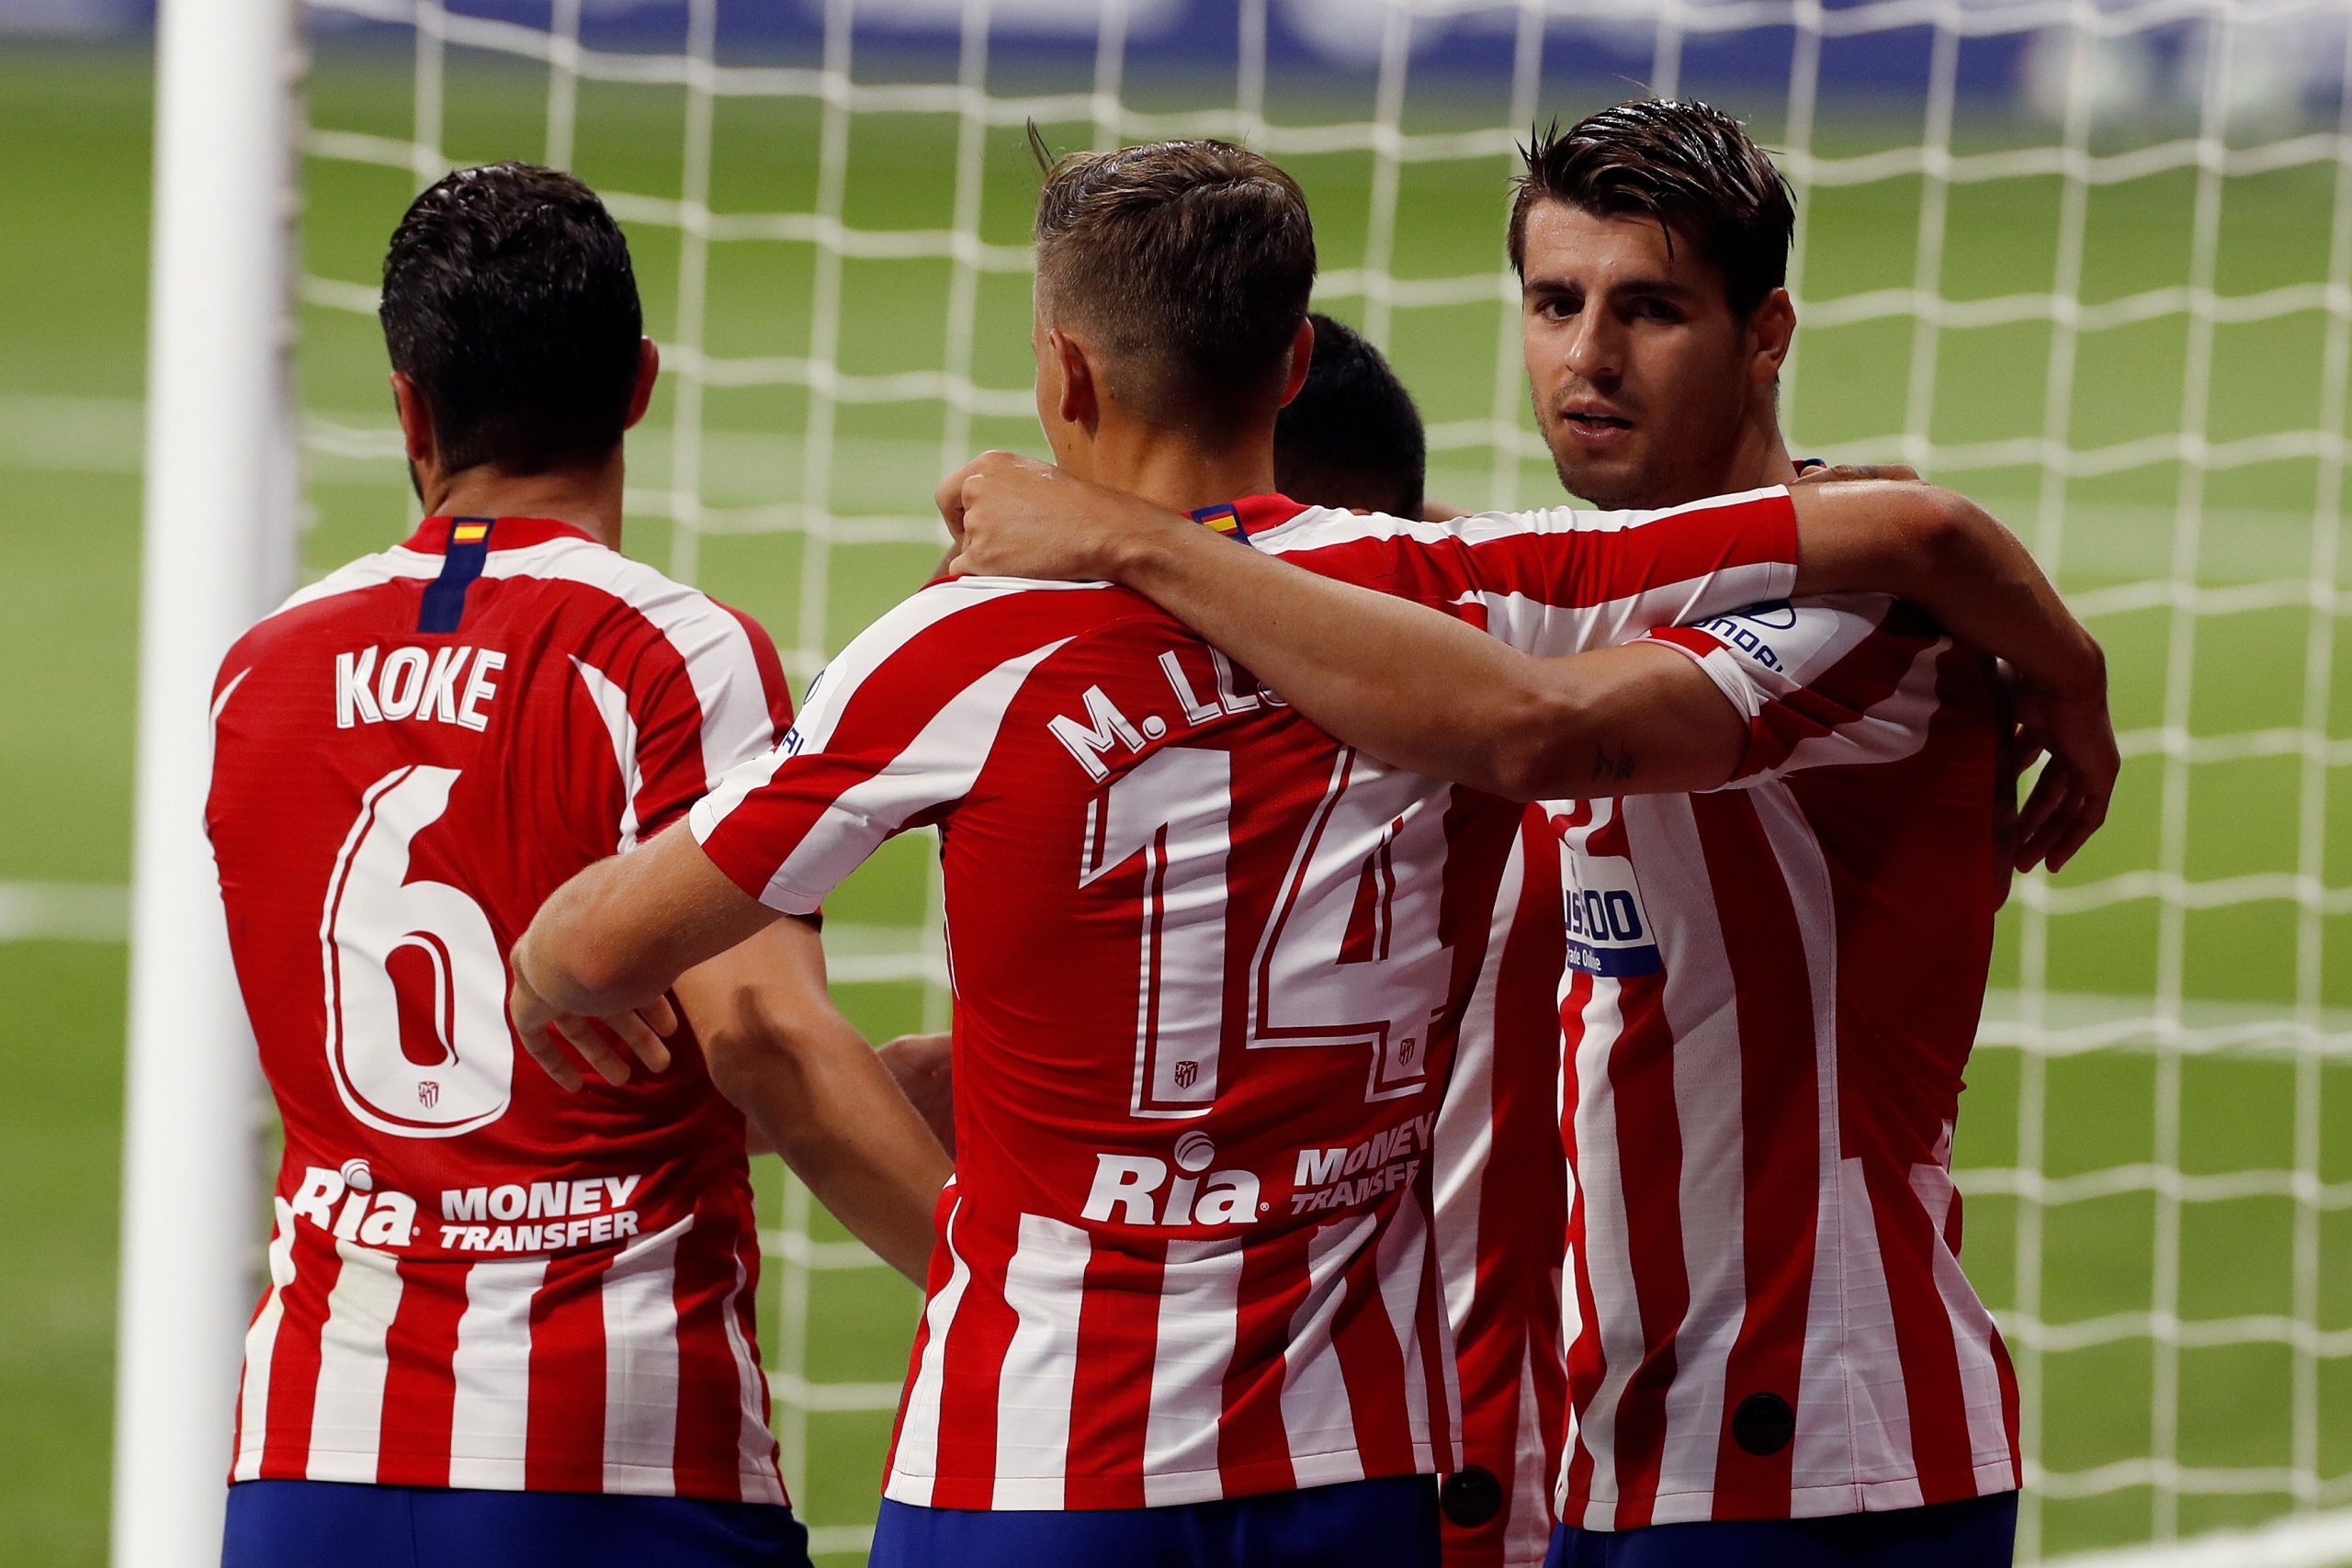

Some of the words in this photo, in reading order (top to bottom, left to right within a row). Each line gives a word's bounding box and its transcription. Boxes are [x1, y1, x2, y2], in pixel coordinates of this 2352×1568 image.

[335, 645, 506, 732] KOKE
[1046, 684, 1166, 784] M.
[320, 764, 514, 1138] 6
[1079, 746, 1453, 1118] 14
[1080, 1131, 1261, 1225] Ria
[1294, 1111, 1434, 1186] MONEY
[291, 1158, 417, 1247] Ria
[439, 1210, 639, 1251] TRANSFER
[441, 1175, 641, 1221] MONEY
